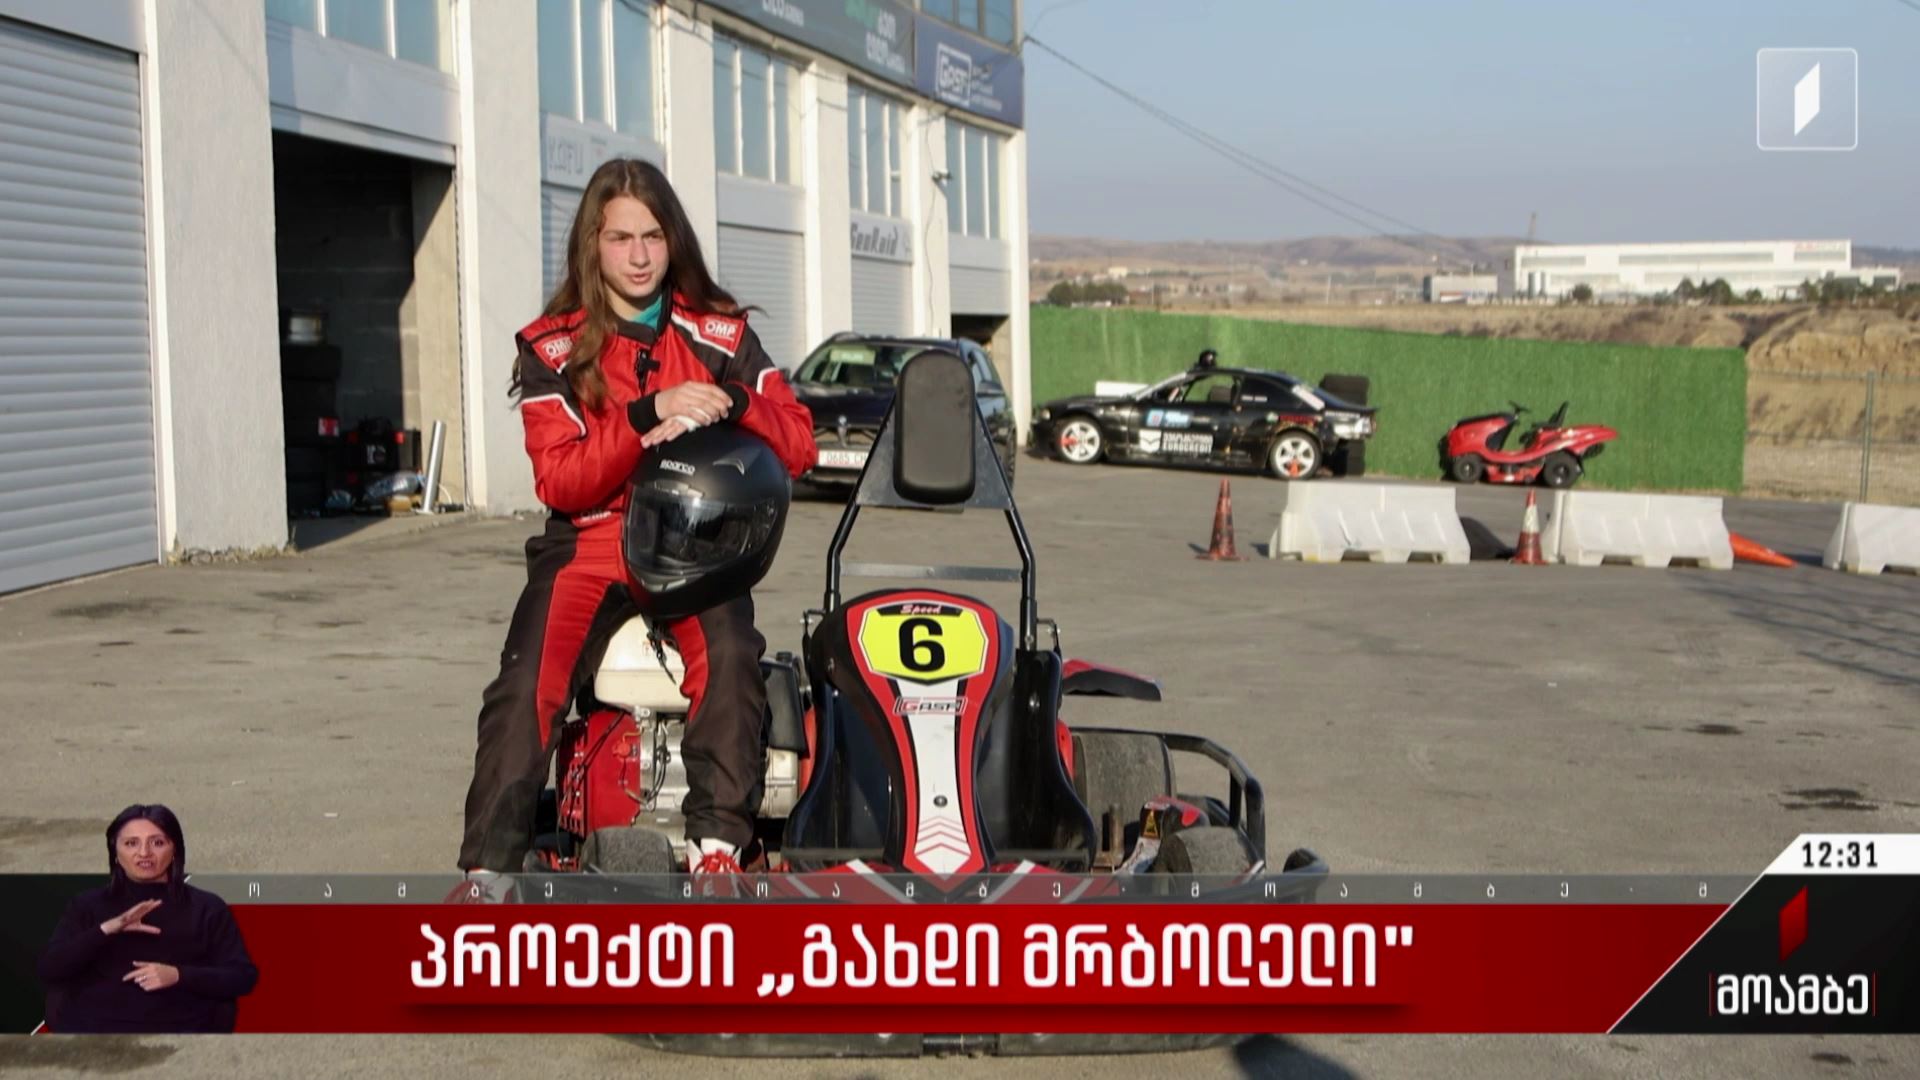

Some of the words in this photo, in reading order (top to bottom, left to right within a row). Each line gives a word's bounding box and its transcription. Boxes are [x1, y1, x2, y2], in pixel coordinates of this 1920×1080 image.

[704, 320, 736, 336] OMP
[900, 604, 942, 616] Speed
[898, 617, 946, 673] 6
